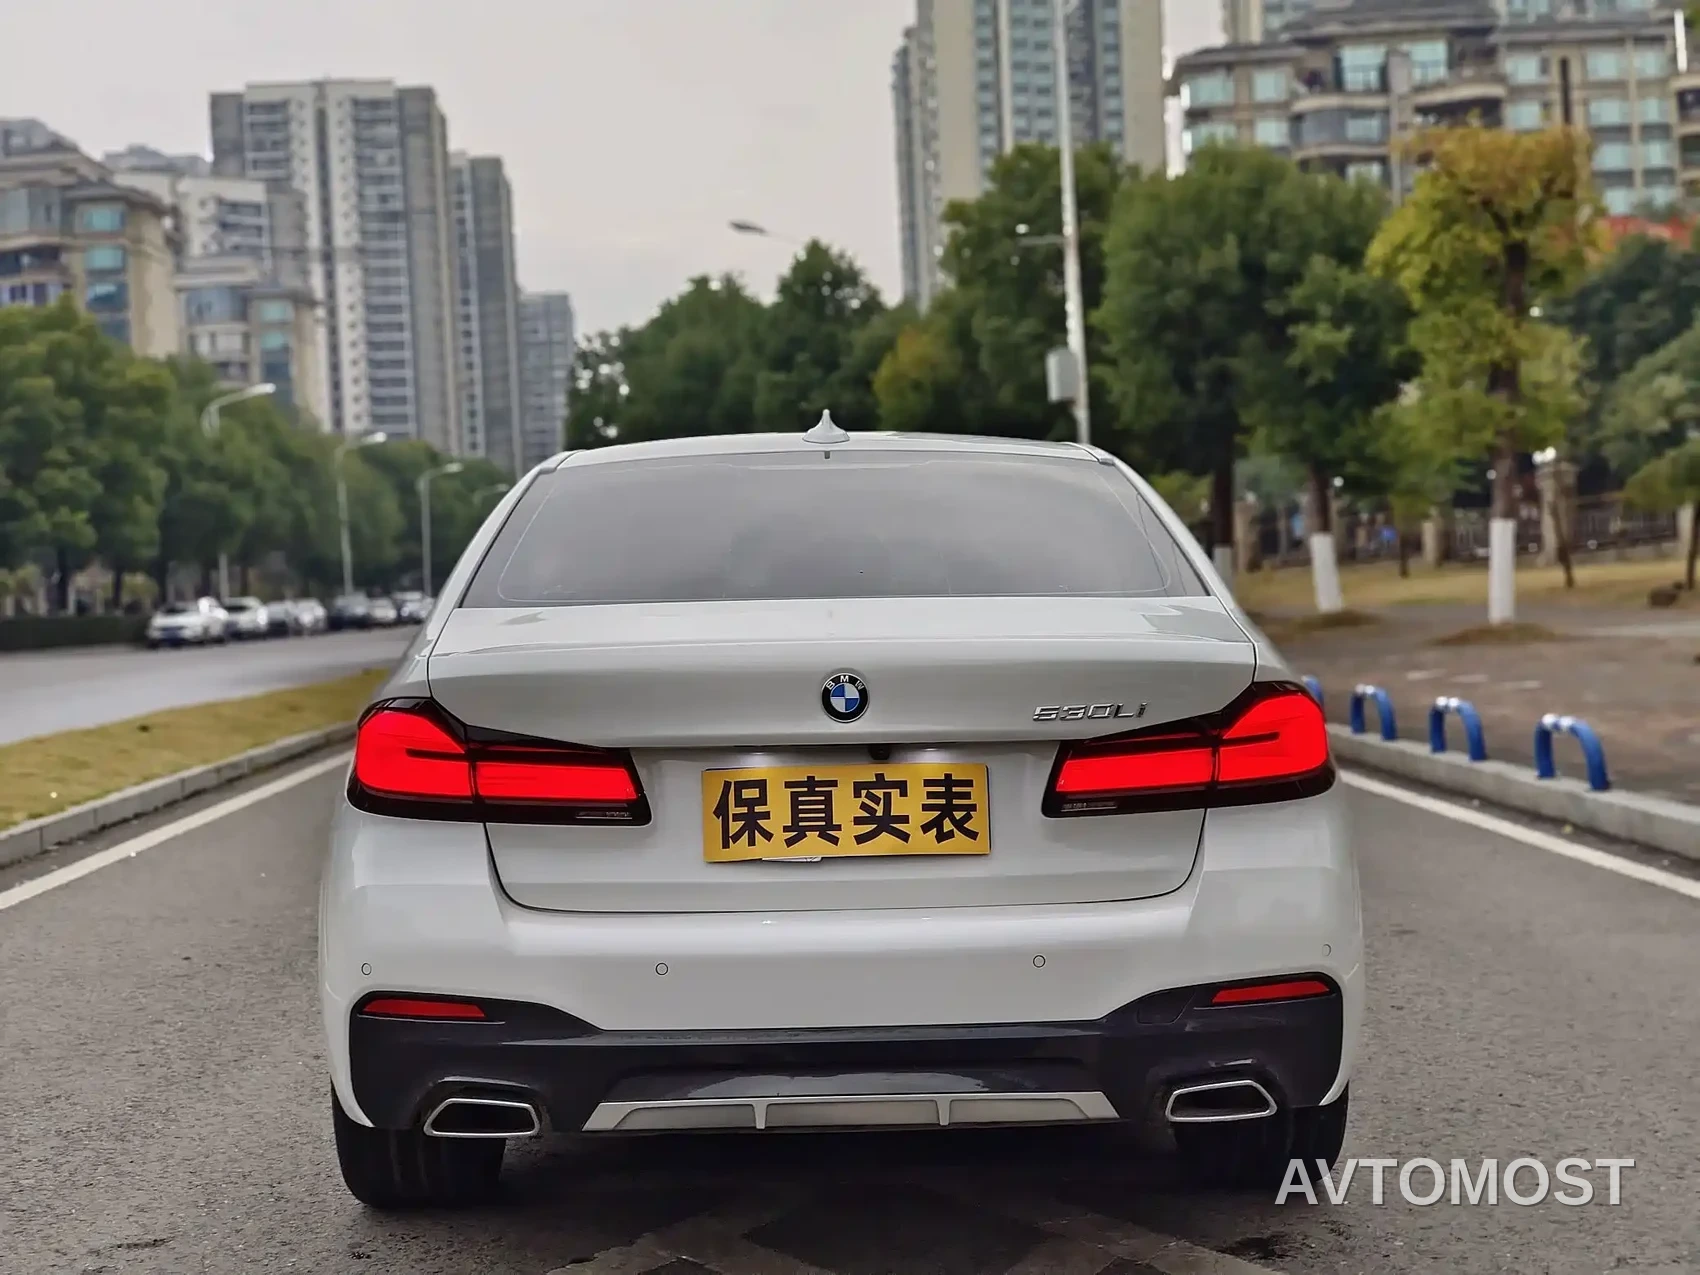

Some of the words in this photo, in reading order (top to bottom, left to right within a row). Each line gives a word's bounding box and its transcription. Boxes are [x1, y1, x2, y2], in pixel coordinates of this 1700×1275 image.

[825, 675, 865, 691] BMW
[1033, 702, 1148, 721] 530Li
[713, 773, 979, 849] 保真实表
